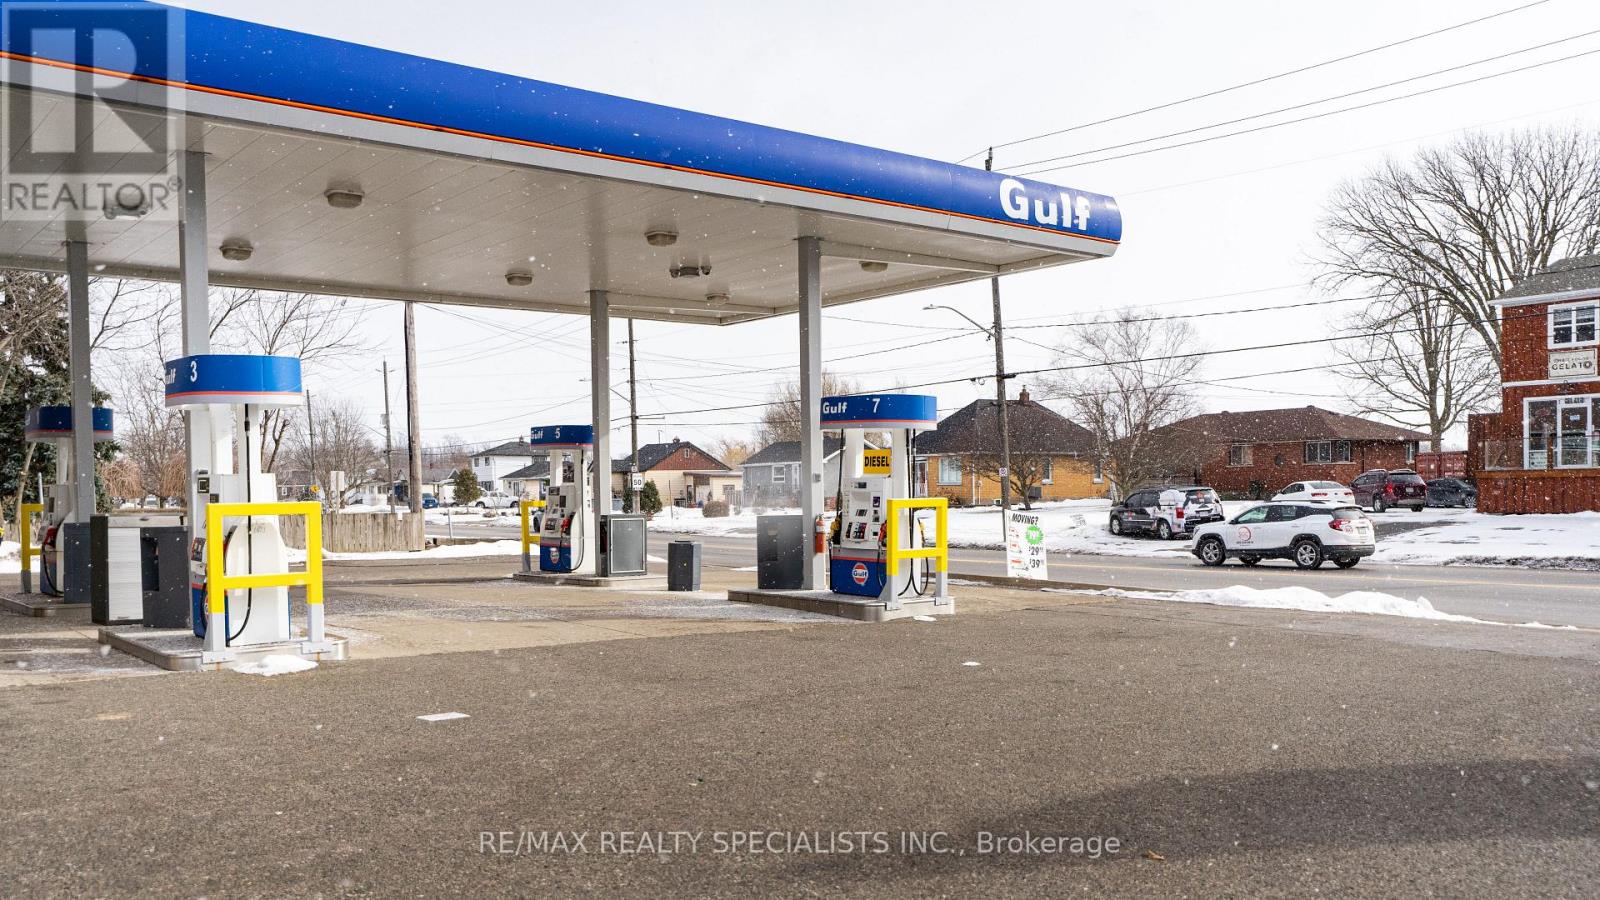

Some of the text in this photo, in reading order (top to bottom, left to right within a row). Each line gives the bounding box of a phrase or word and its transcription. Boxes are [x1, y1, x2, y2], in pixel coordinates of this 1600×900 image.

[1000, 178, 1091, 231] Gulf
[190, 360, 198, 383] 3
[1552, 361, 1592, 370] GELATO
[822, 402, 848, 414] Gulf
[872, 398, 881, 413] 7
[864, 456, 890, 467] DIESEL
[1011, 512, 1039, 526] MOVING?
